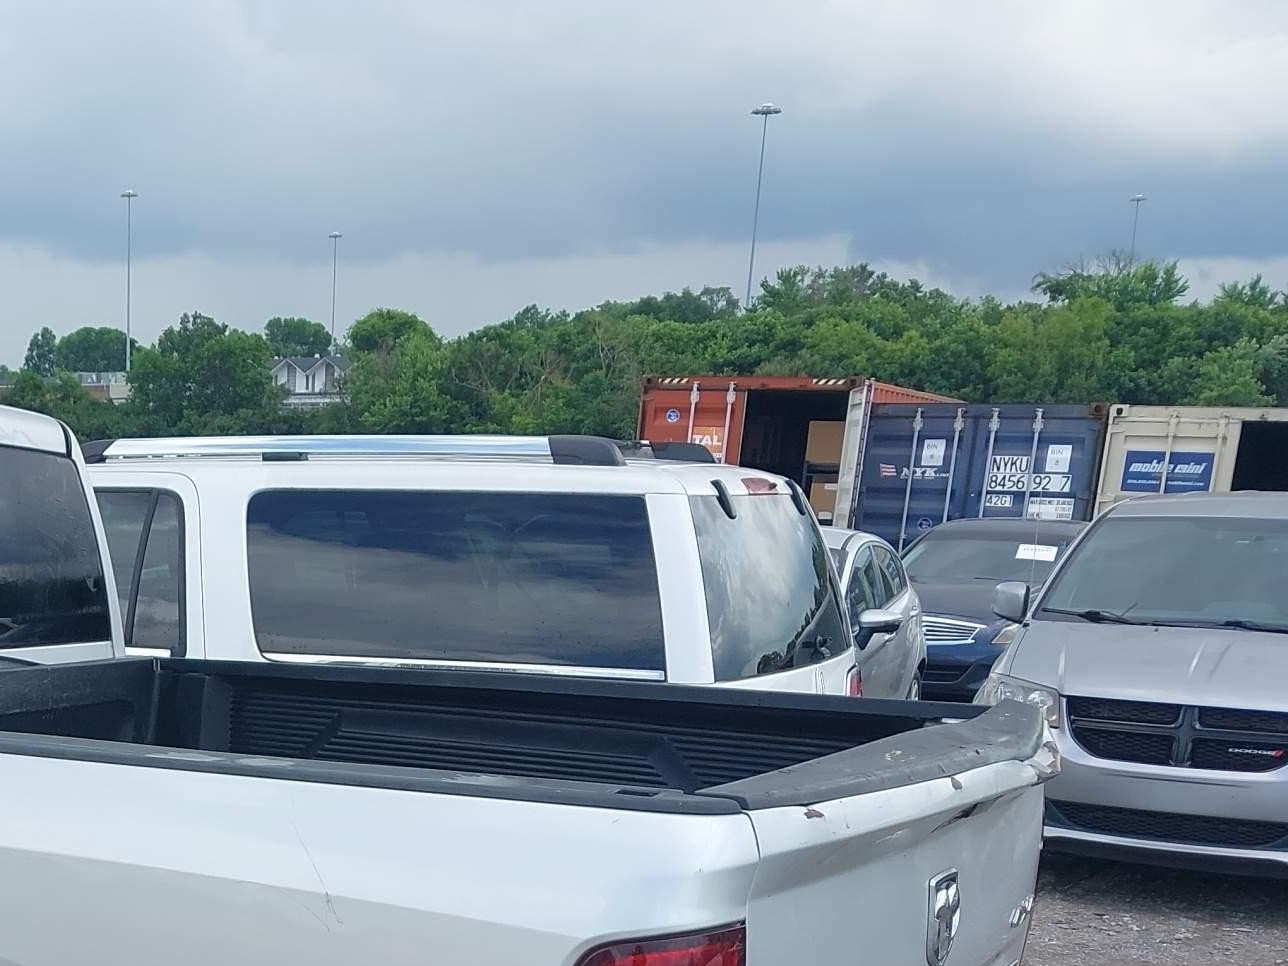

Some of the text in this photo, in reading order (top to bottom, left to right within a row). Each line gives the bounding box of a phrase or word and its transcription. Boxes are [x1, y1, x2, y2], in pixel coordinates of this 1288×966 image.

[692, 434, 722, 446] TAL
[991, 457, 1030, 473] NYKU
[1060, 476, 1071, 491] 7
